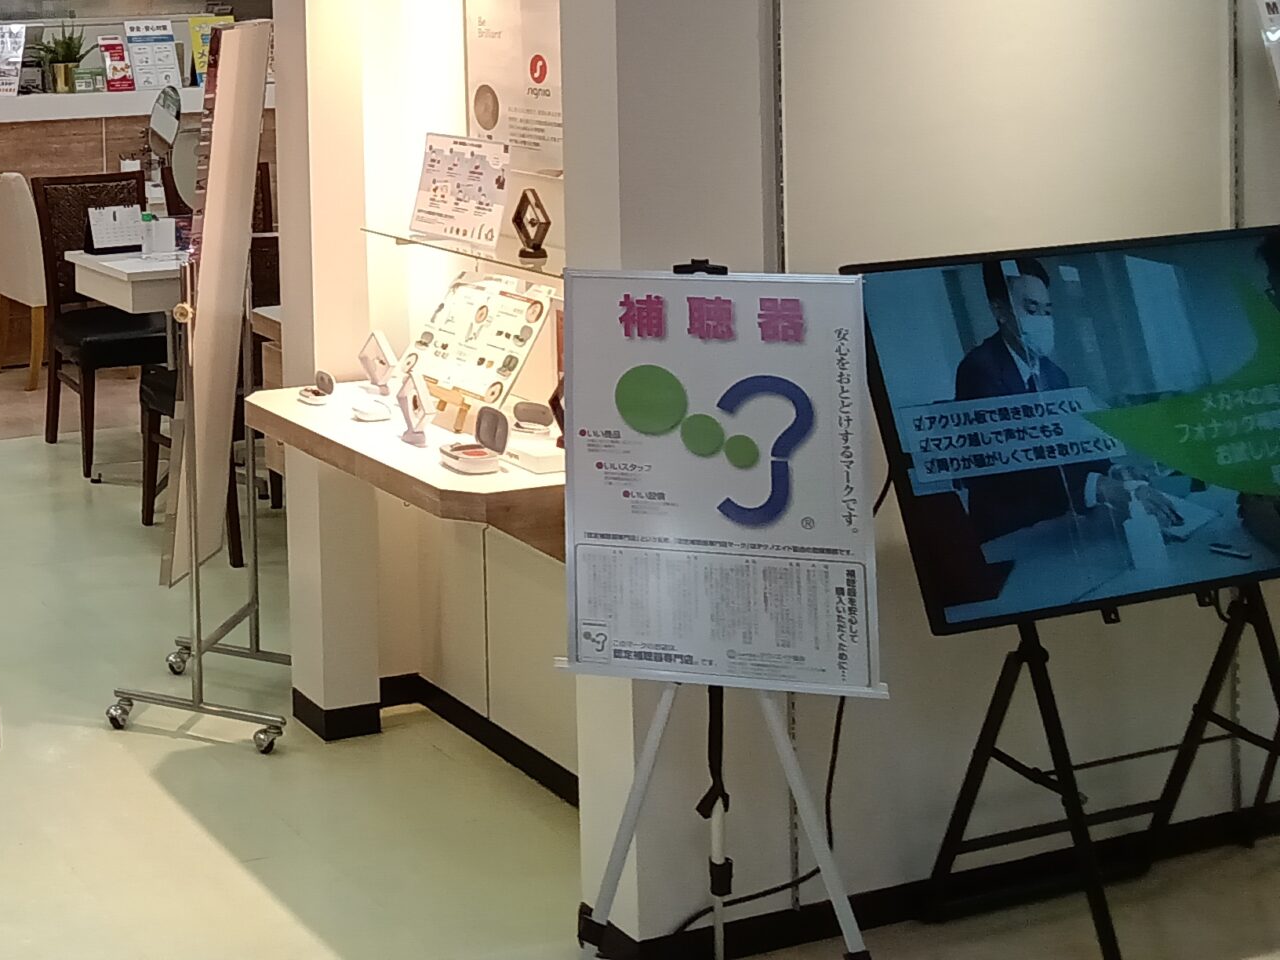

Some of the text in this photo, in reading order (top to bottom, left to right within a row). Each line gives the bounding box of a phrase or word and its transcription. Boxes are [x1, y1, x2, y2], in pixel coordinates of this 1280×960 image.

[618, 293, 804, 343] 補聴器
[834, 327, 859, 534] 安心をおとどけするマークです。
